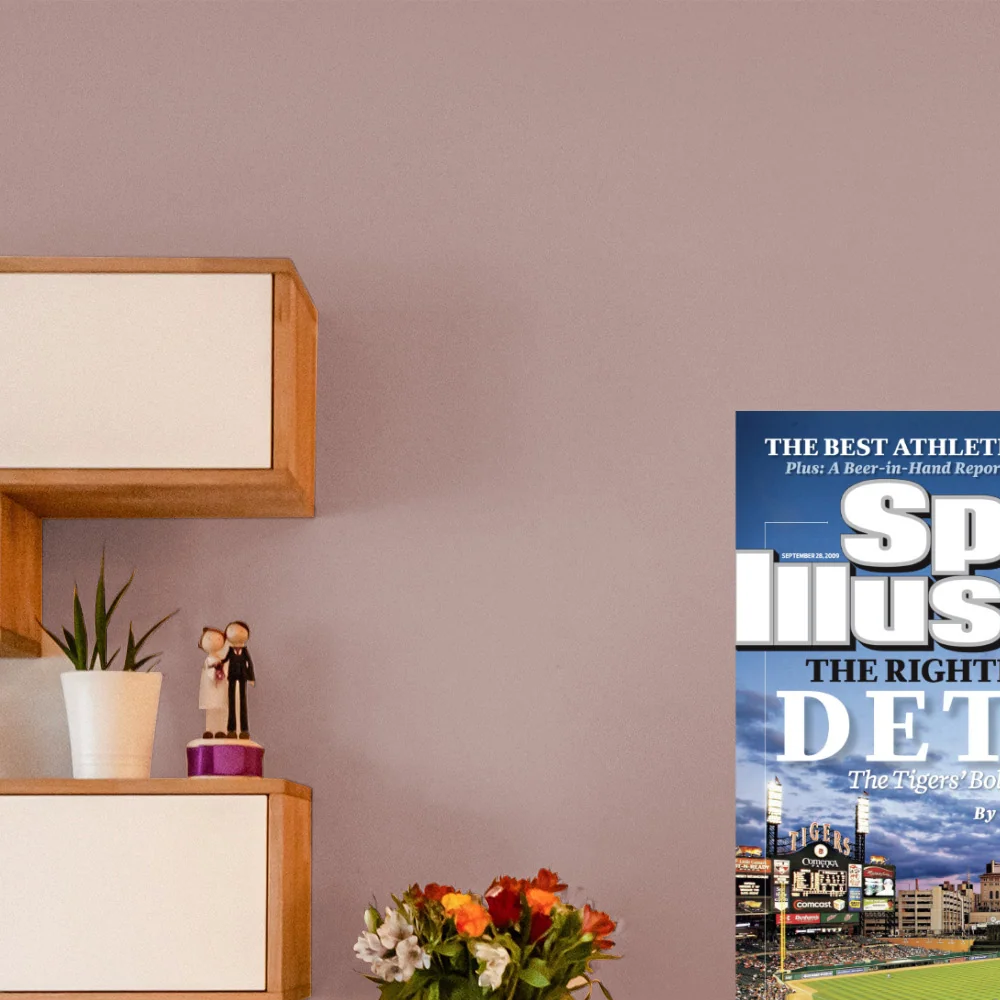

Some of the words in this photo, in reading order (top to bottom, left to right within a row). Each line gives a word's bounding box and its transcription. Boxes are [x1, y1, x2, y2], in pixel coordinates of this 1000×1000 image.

[765, 438, 818, 456] THE
[824, 438, 888, 456] BEST
[785, 461, 824, 475] Plus:
[828, 462, 840, 475] A
[844, 461, 951, 475] Beer-in-Hand
[806, 658, 878, 683] THE
[849, 770, 889, 789] The
[973, 807, 996, 824] By
[789, 822, 851, 856] TIGERS
